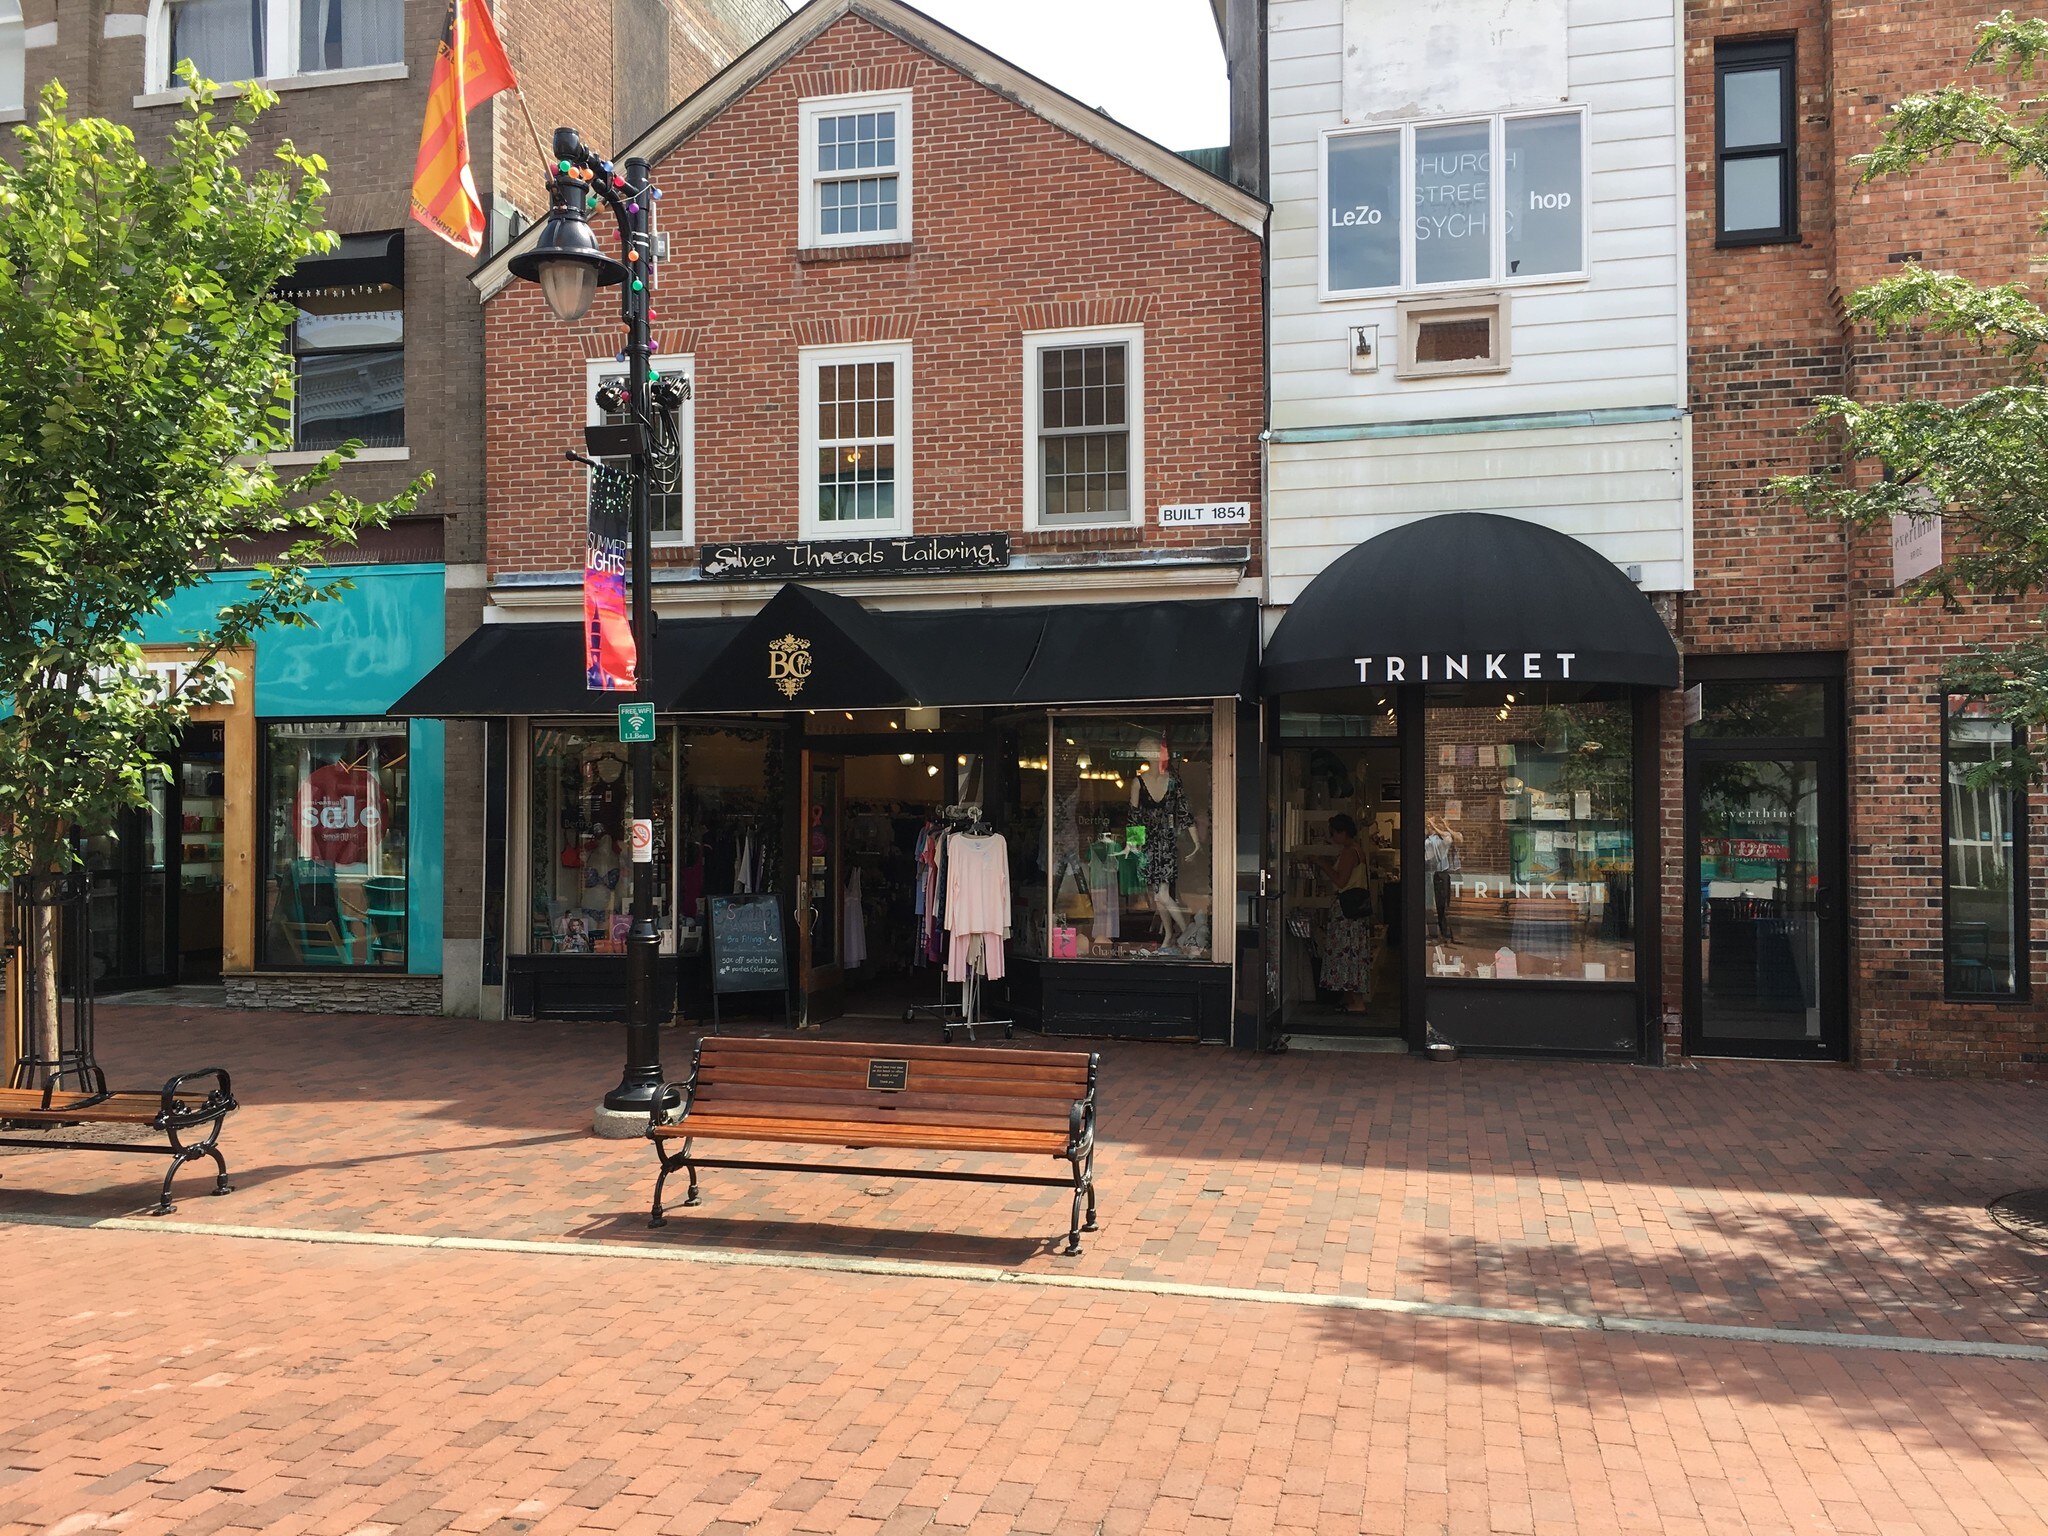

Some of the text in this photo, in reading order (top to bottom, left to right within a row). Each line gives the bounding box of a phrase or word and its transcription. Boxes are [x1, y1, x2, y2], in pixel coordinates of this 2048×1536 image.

[1332, 190, 1571, 227] LeZo hop
[1164, 506, 1246, 521] BUILT 1854
[587, 531, 626, 558] SUMMER
[715, 538, 993, 569] Silver Threads Tailoring
[587, 547, 625, 577] LIGHTS
[1354, 653, 1576, 683] TRINKET
[302, 796, 382, 829] sale
[1720, 807, 1796, 819] everthine
[1450, 881, 1605, 900] TRINKET
